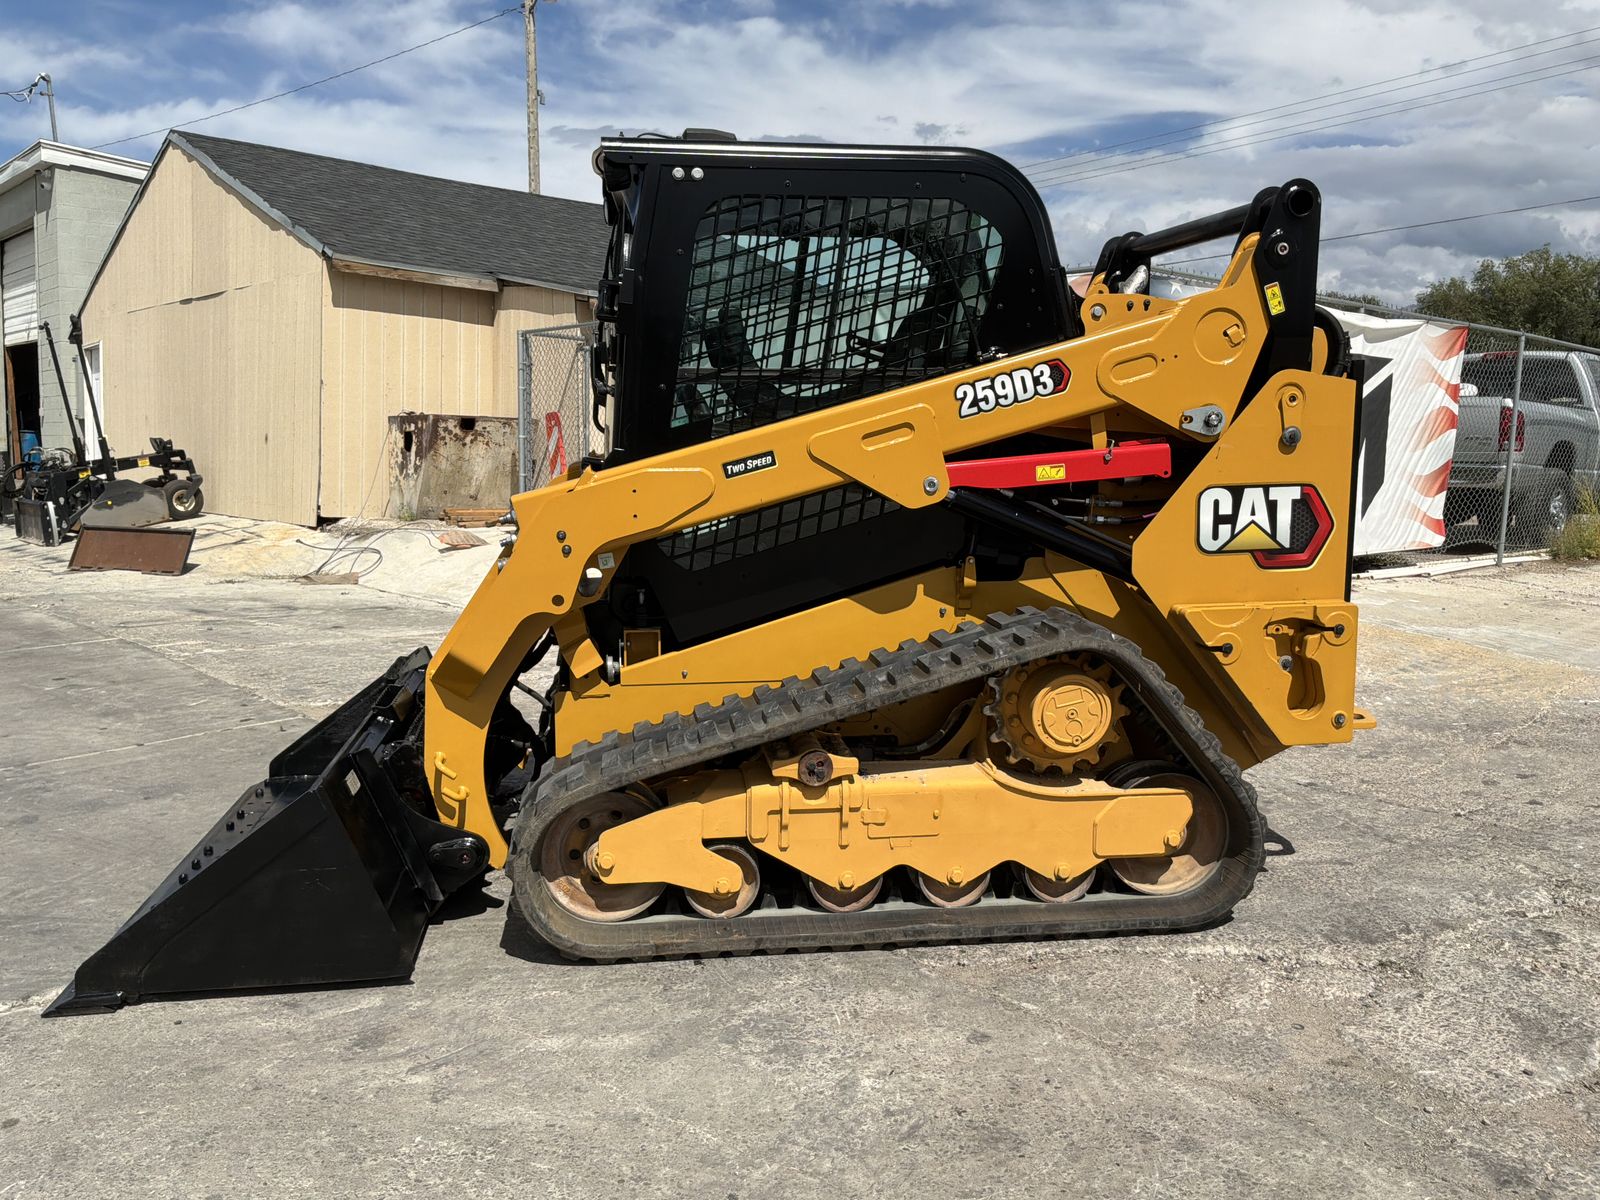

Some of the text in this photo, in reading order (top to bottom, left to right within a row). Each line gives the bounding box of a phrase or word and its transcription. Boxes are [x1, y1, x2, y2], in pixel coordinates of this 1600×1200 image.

[956, 363, 1054, 417] 259D3
[727, 456, 772, 475] TWO SPEED
[1199, 486, 1302, 552] CAT
